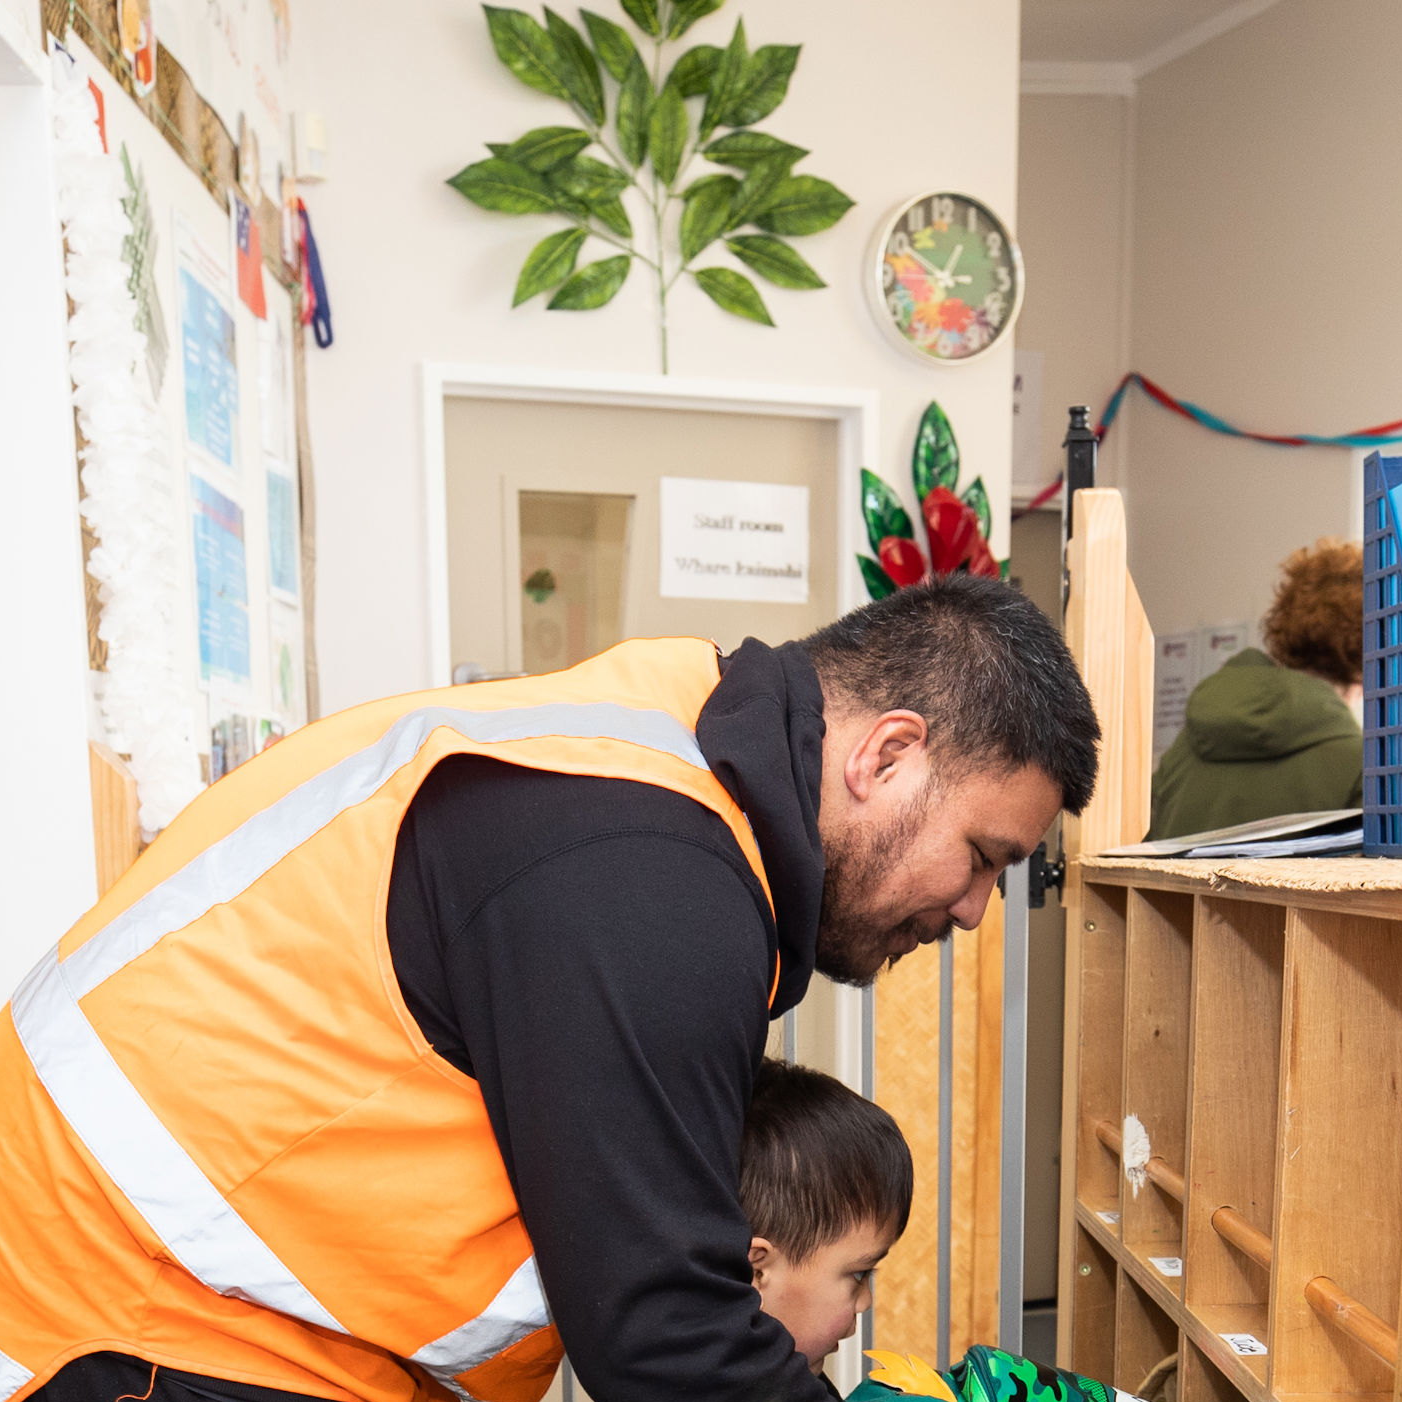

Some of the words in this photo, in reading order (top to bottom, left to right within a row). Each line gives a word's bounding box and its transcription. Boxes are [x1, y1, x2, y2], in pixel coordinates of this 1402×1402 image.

[931, 197, 955, 224] 12
[694, 513, 734, 531] Staff
[739, 520, 784, 534] room
[675, 556, 732, 577] Whare
